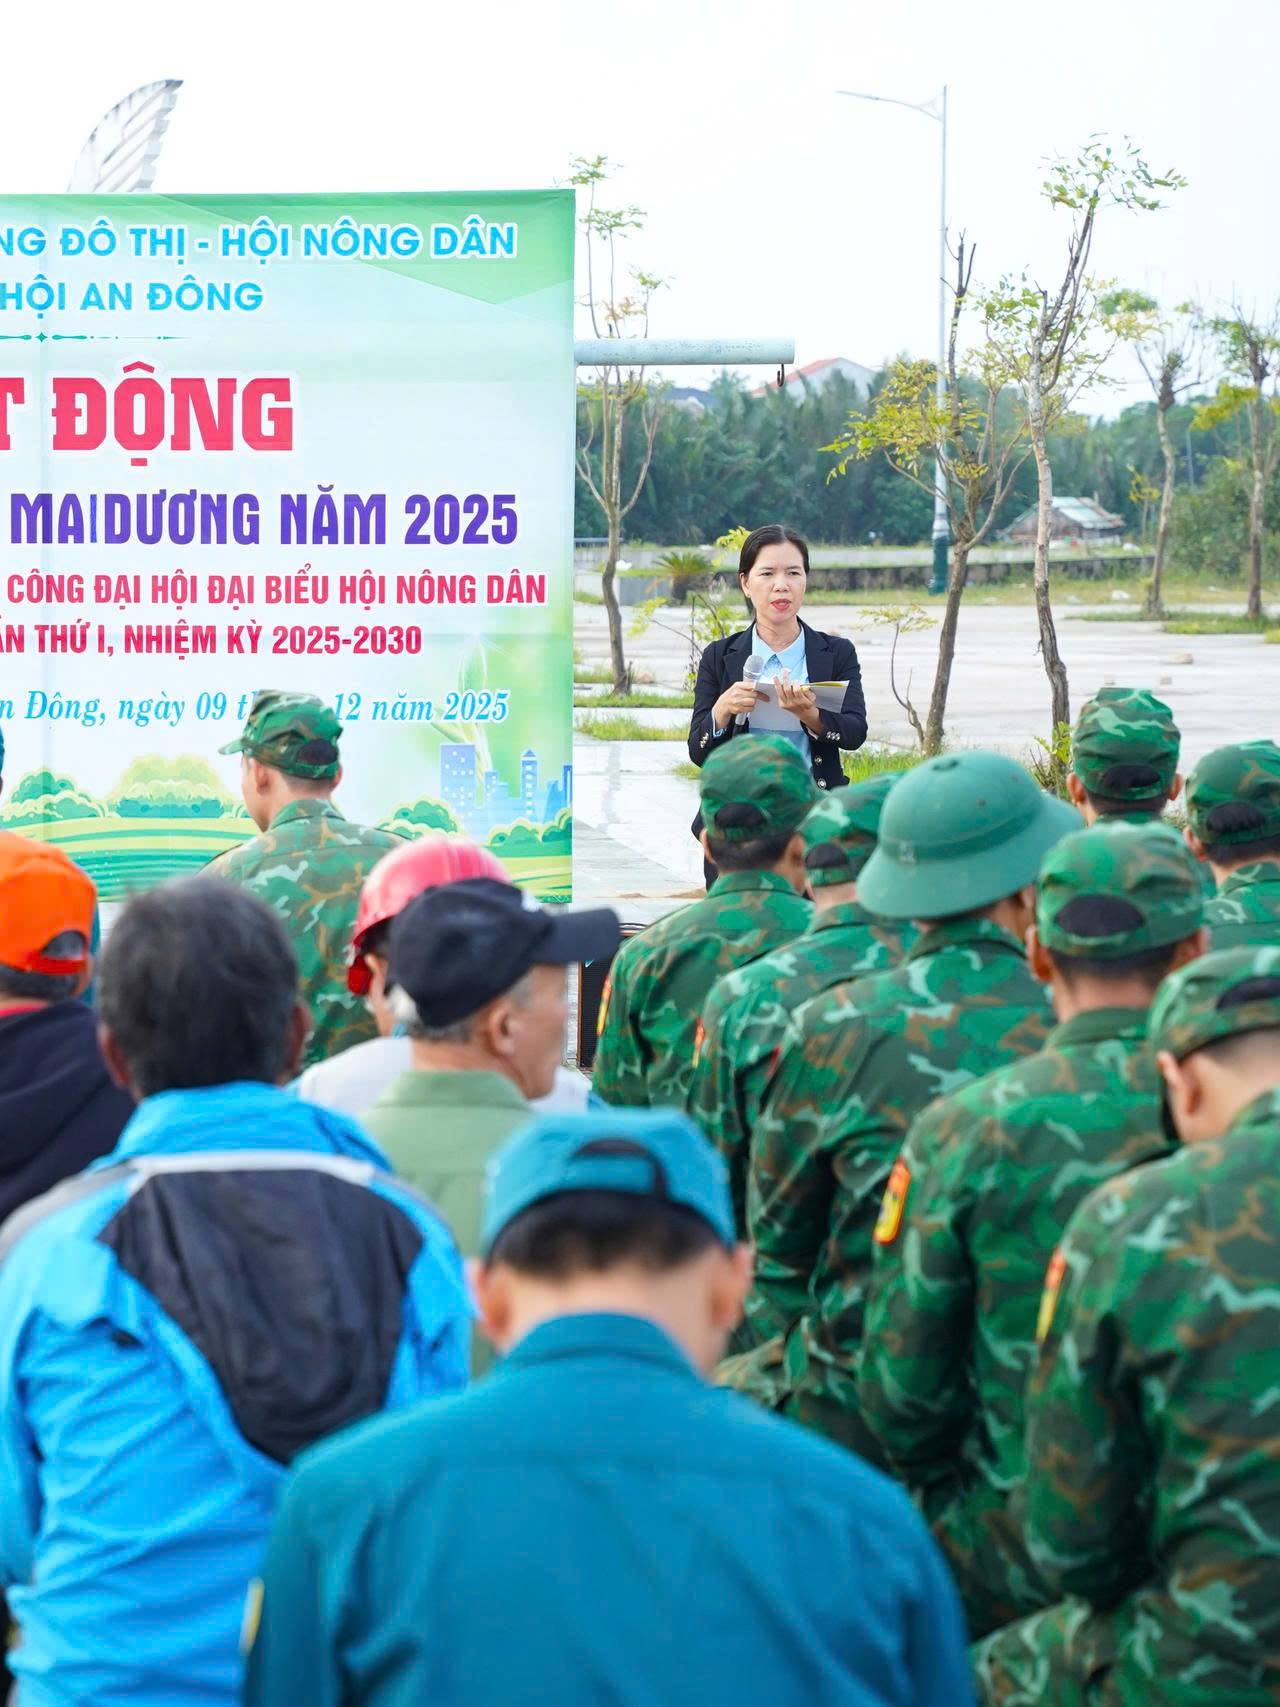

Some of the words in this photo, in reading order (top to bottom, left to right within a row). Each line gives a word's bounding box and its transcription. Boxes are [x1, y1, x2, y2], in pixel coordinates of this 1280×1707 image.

[59, 219, 117, 257] ĐÔ
[129, 227, 185, 265] THỊ
[221, 219, 289, 265] HỘI
[303, 219, 421, 257] NÔNG
[433, 218, 515, 256] DÂN
[0, 274, 66, 319] HỘI
[80, 282, 133, 311] AN
[146, 274, 263, 311] ĐÔNG
[51, 361, 294, 467] ĐỘNG
[280, 484, 387, 545] NĂM
[404, 494, 518, 545] 2025
[7, 568, 85, 604] CÔNG
[93, 574, 141, 610] ĐẠI
[151, 568, 198, 611] HỘI
[207, 574, 255, 611] ĐẠI
[264, 563, 329, 605] BIỂU
[339, 568, 386, 611] HỘI
[396, 569, 477, 605] NÔNG
[486, 569, 546, 604] DÂN
[33, 619, 91, 654] THỨ
[97, 625, 114, 657] I,
[123, 618, 217, 661] NHIỆM
[226, 619, 263, 654] KỲ
[272, 625, 422, 655] 2025-2030
[24, 690, 107, 727] Đông,
[118, 690, 186, 727] ngày
[196, 691, 228, 720] 09
[334, 692, 363, 721] 12
[371, 692, 434, 721] năm
[443, 692, 510, 721] 2025
